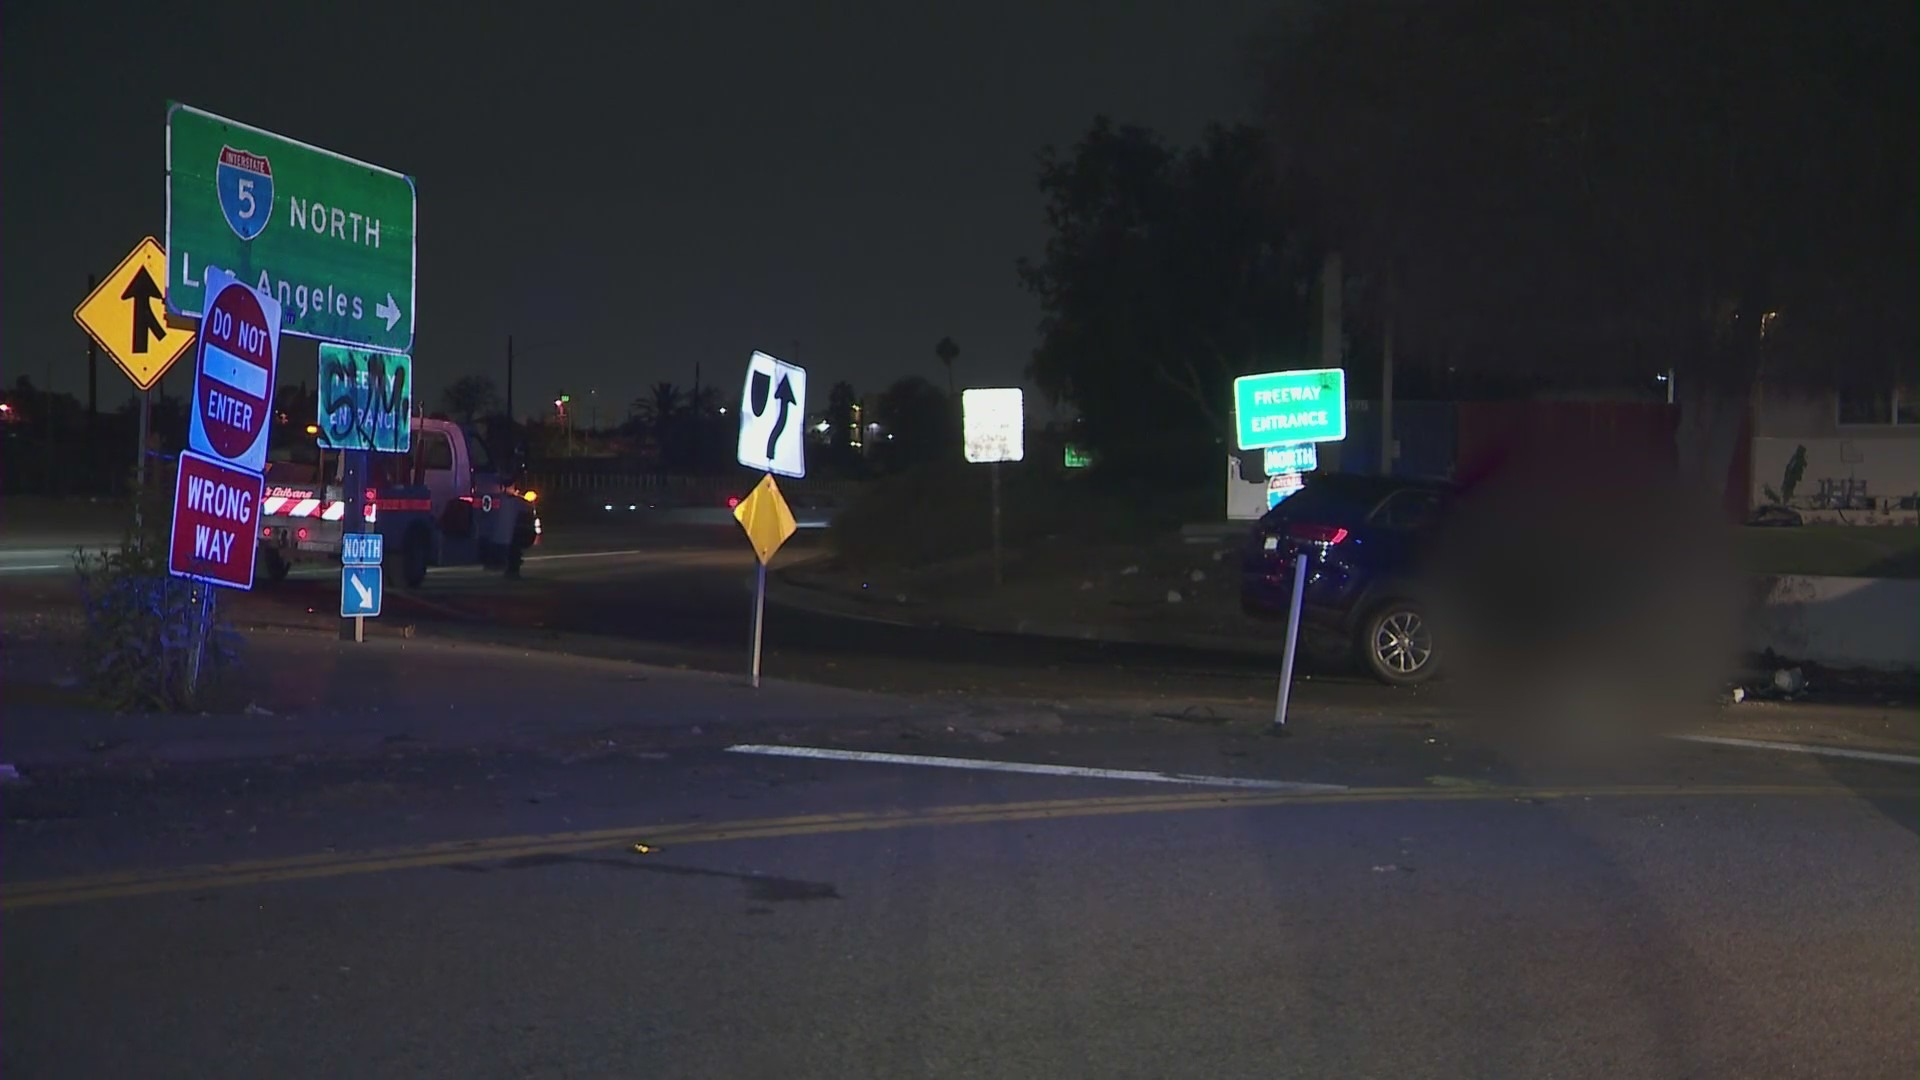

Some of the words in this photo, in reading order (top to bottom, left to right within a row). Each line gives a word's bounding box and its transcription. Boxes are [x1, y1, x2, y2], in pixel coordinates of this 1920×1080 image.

[225, 151, 265, 173] INTERSTATE
[237, 177, 257, 220] 5
[289, 195, 381, 249] NORTH
[256, 268, 364, 321] Angeles
[212, 307, 232, 342] DO
[238, 317, 268, 358] NOT
[207, 390, 253, 434] ENTER
[1254, 387, 1321, 405] FREEWAY
[1252, 411, 1328, 432] ENTRANCE
[1267, 447, 1313, 469] NORTH
[187, 475, 251, 525] WRONG
[194, 524, 235, 565] WAY
[344, 537, 382, 559] NORTH
